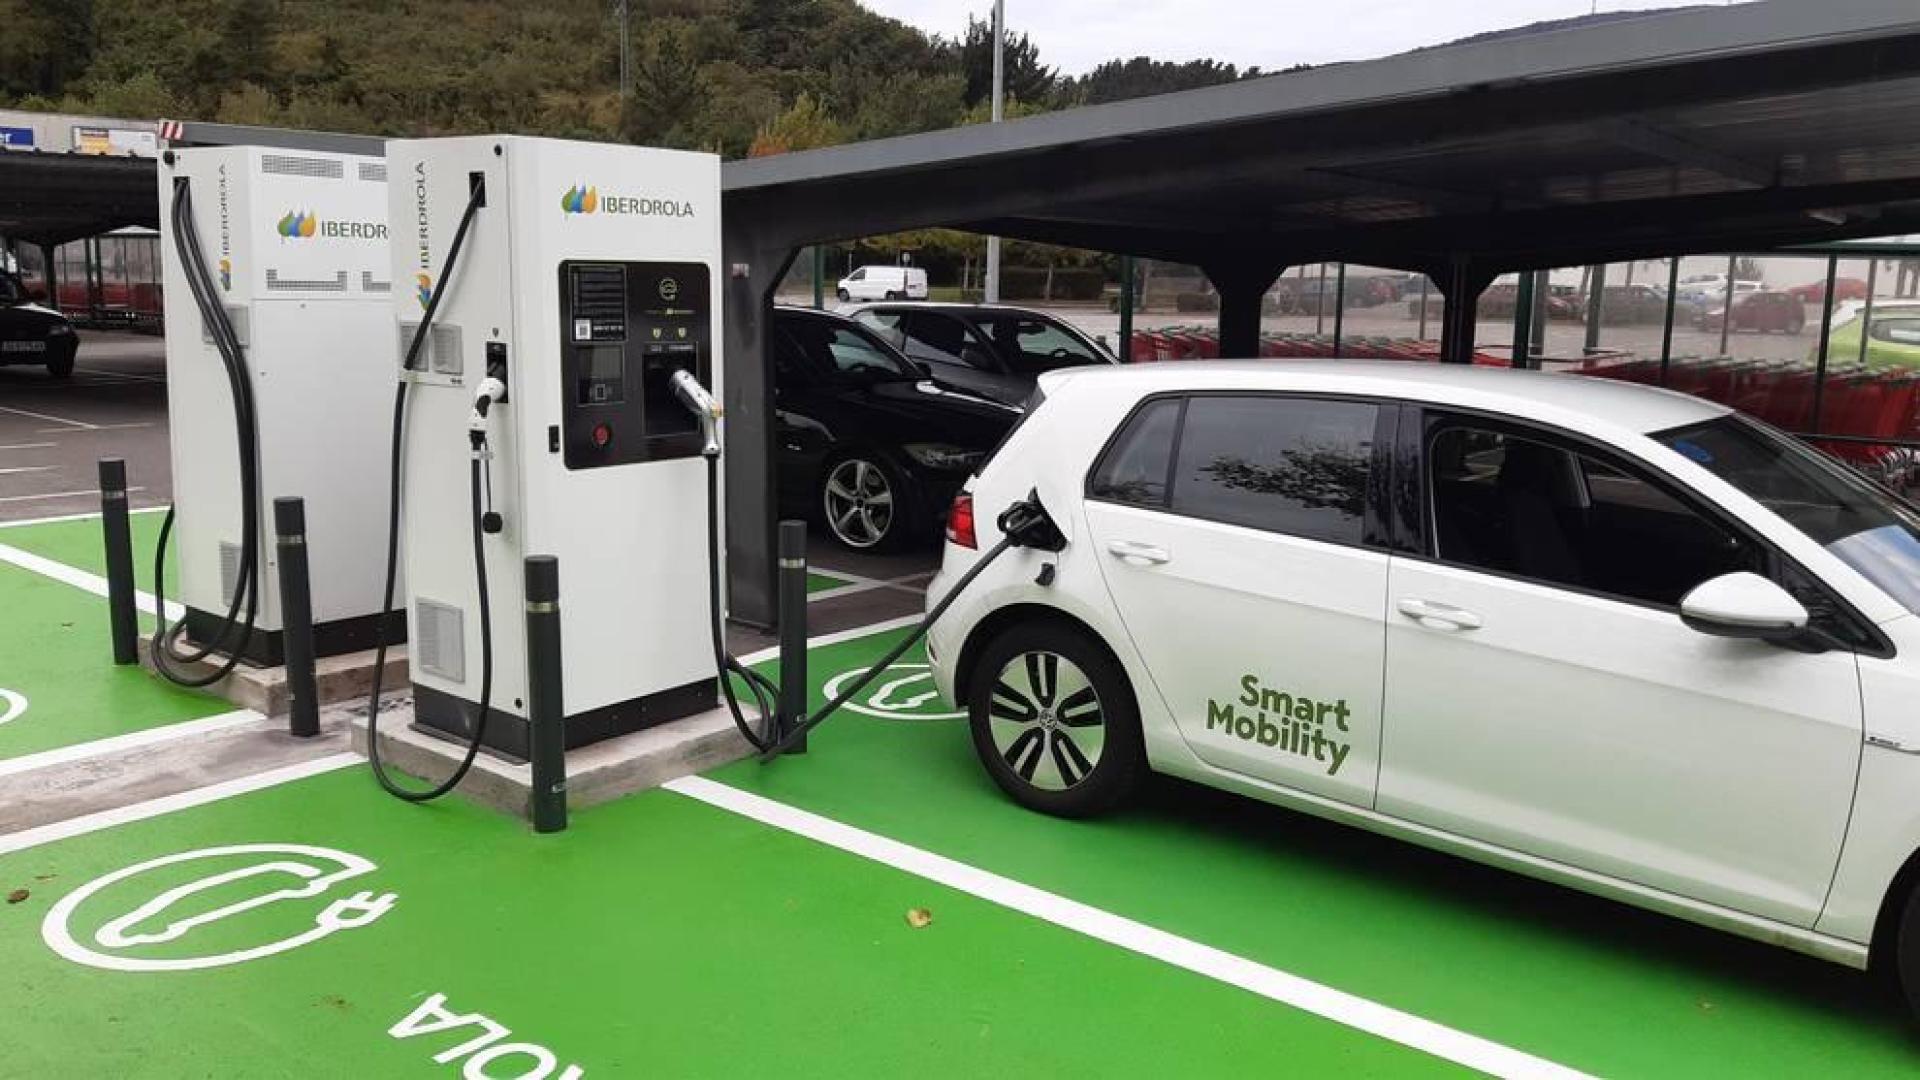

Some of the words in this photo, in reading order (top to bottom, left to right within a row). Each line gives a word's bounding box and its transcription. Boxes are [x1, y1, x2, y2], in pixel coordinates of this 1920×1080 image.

[415, 161, 430, 268] IBERDROLA
[601, 196, 695, 217] IBERDROLA
[1207, 700, 1350, 775] Mobility
[1239, 674, 1350, 731] Smart
[387, 992, 584, 1080] OLA
